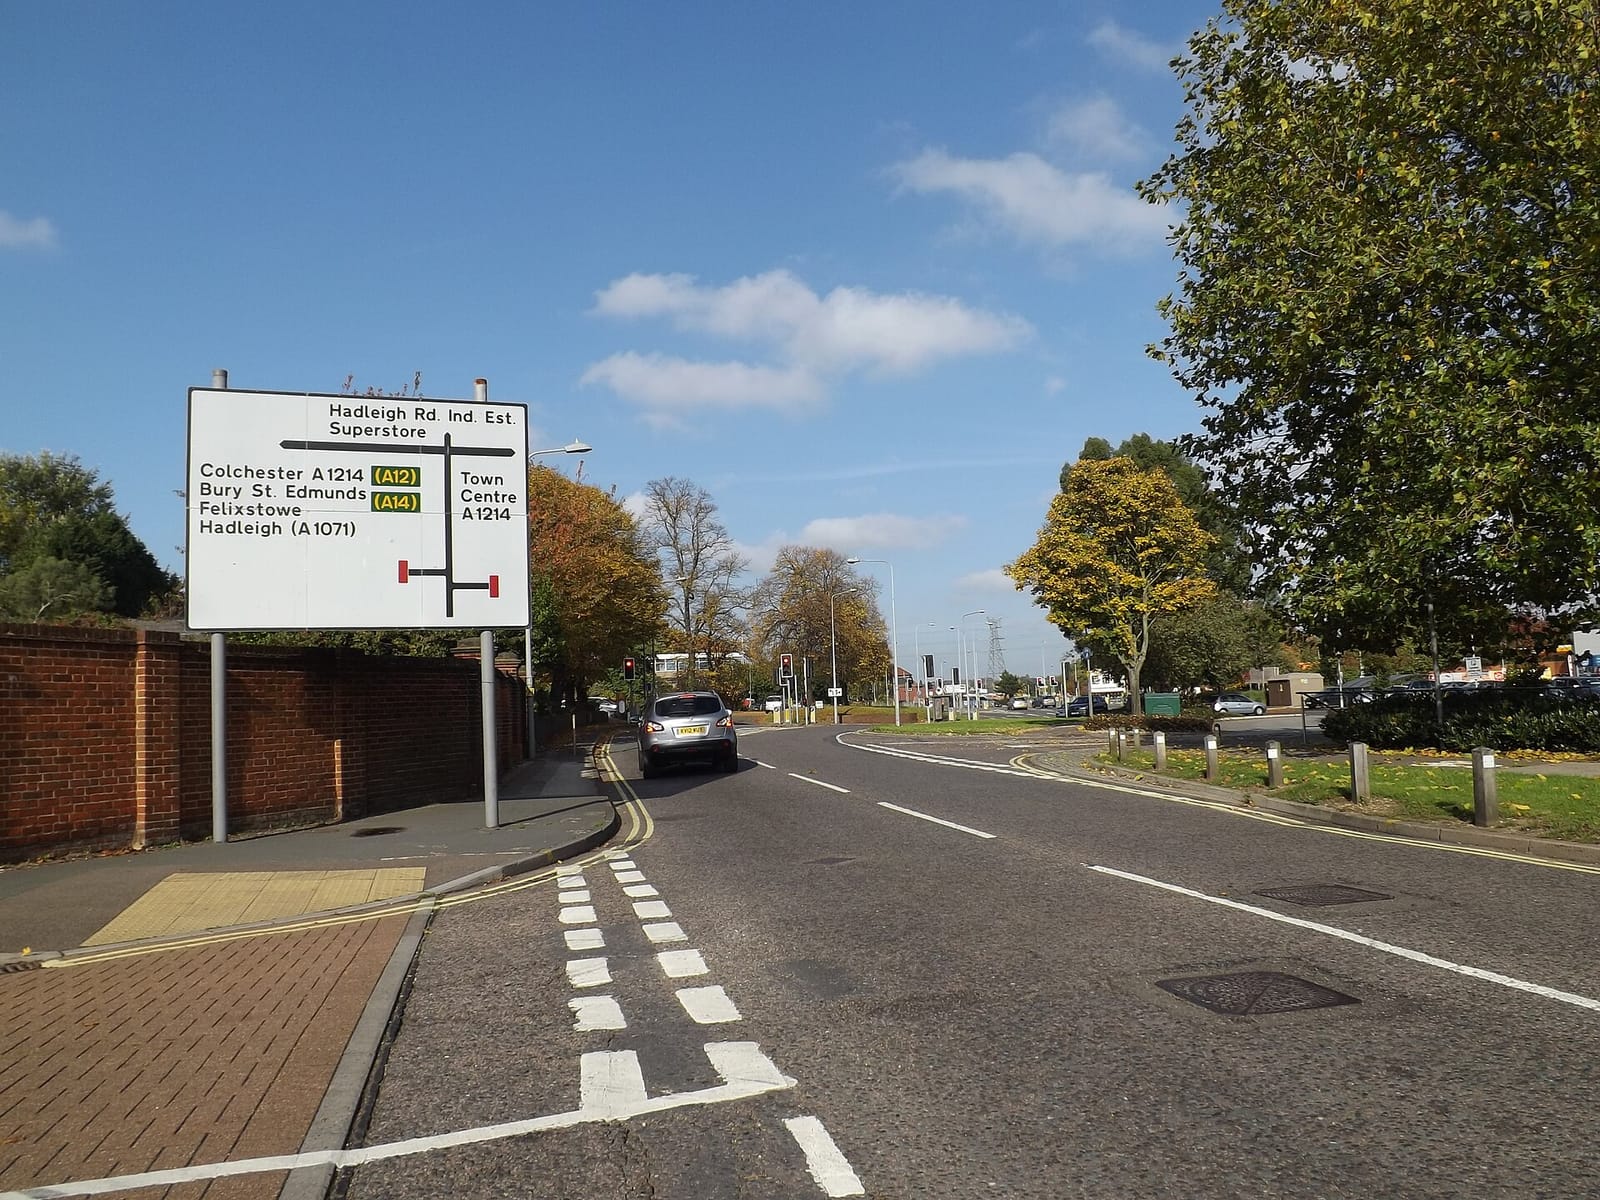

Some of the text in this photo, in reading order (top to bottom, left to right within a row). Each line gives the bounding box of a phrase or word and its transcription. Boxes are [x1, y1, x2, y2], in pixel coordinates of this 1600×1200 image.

[329, 404, 516, 425] Hadleigh Rd. Ind. Est.
[329, 421, 427, 438] Superstore
[200, 463, 416, 485] Colchester A1214 (A12)
[460, 471, 504, 486] Town
[200, 482, 417, 511] Bury St. Edmunds (A14)
[460, 489, 517, 504] Centre
[199, 501, 302, 517] Felixstowe
[461, 507, 512, 521] A1214
[199, 519, 356, 538] Hadleigh (A1071)
